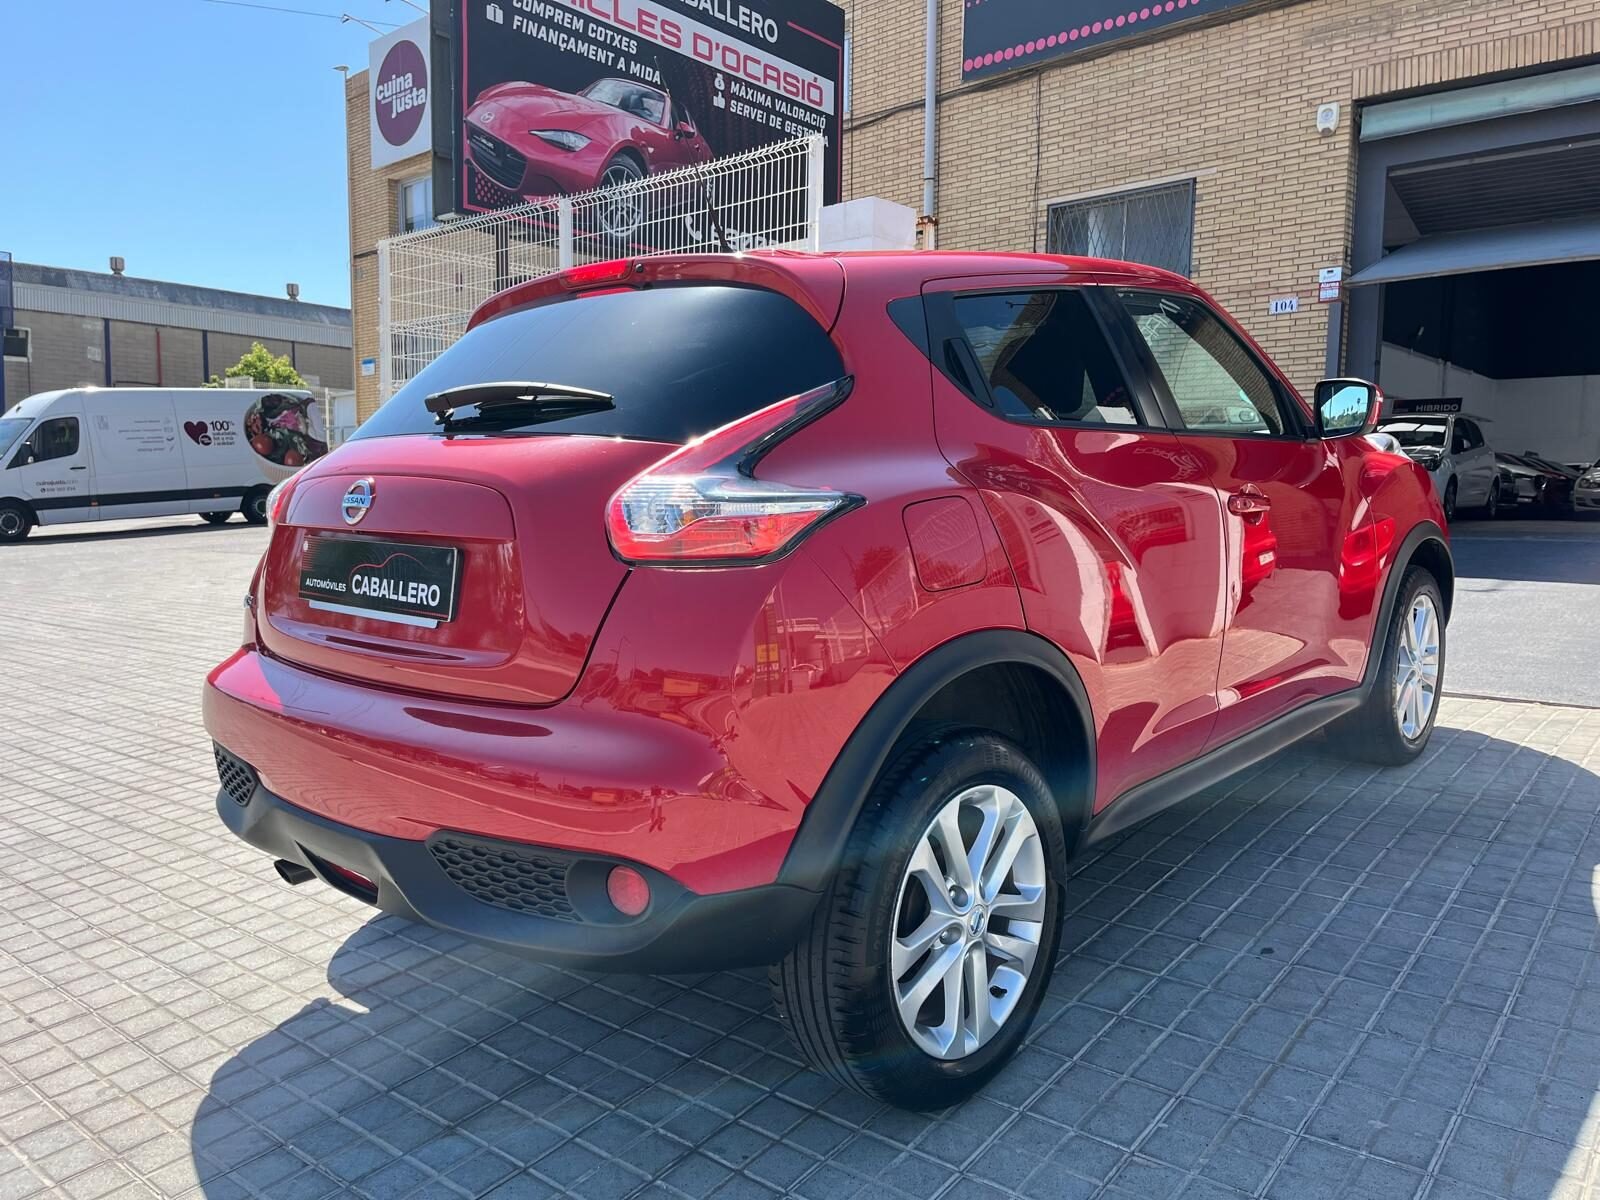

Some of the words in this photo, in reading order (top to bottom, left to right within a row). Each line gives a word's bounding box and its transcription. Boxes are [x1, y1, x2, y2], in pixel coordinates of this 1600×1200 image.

[513, 15, 615, 67] FINANÇAMENT
[617, 57, 626, 72] A
[630, 61, 661, 85] MIDA
[588, 22, 638, 55] COTXES
[693, 31, 824, 108] D'OCASIÓ
[376, 72, 413, 100] cuina
[391, 87, 426, 119] justa
[730, 81, 772, 109] MÀXIMA
[775, 99, 826, 130] VALORACIÓ
[730, 100, 767, 124] SERVEI
[769, 114, 782, 130] DE
[1275, 300, 1293, 312] 104
[1415, 403, 1459, 412] HIBRIDO
[305, 577, 347, 592] AUTOMÓVILES
[352, 574, 441, 607] CABALLERO
